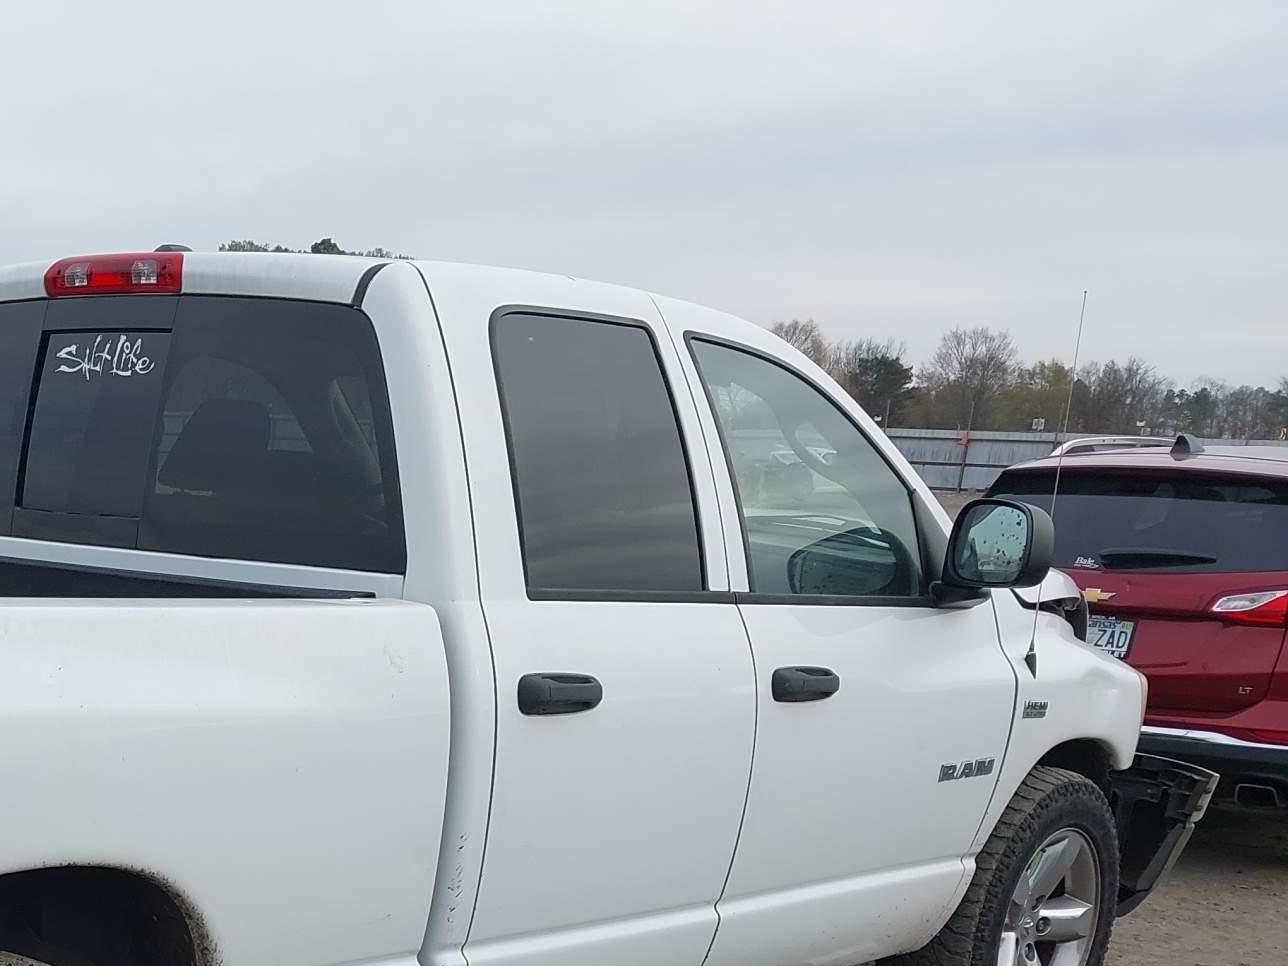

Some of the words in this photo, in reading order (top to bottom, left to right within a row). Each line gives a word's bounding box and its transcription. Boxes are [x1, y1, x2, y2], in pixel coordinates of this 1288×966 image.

[1088, 620, 1117, 630] ansas
[1094, 629, 1128, 649] ZAD
[938, 759, 995, 782] RAM
